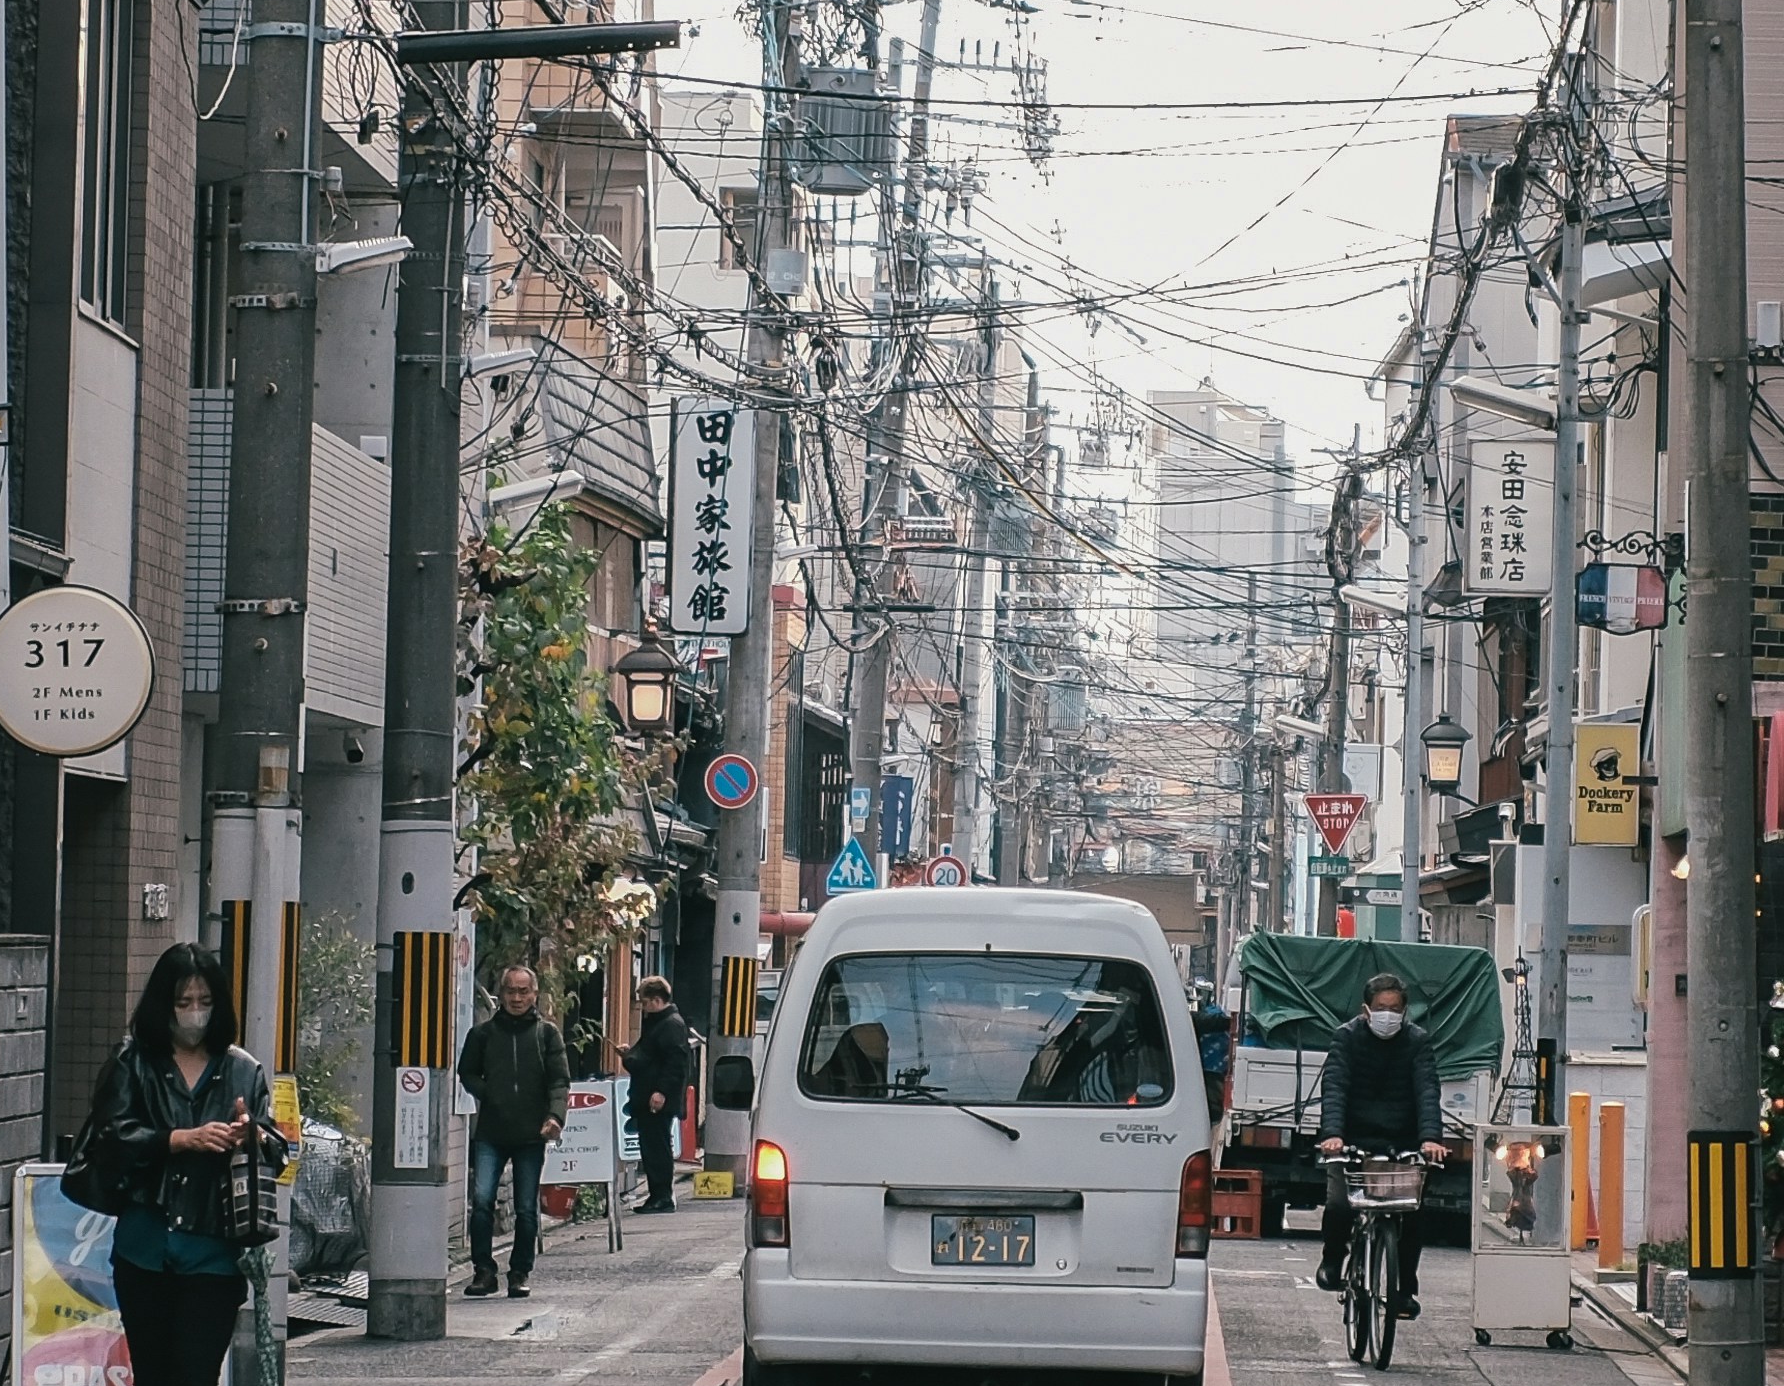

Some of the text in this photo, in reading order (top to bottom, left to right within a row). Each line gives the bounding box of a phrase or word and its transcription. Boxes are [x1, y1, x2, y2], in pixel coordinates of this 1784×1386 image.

[687, 413, 733, 622] 田中家旅館
[1500, 450, 1528, 582] 安田念珠店
[1480, 505, 1494, 580] 本店営業部
[30, 622, 100, 633] サンイチナナ
[24, 639, 105, 668] 317
[32, 688, 103, 699] 2F Mens
[34, 708, 95, 721] 1F Kids
[1578, 786, 1634, 802] Dockery
[1316, 801, 1354, 815] 止まれ
[1588, 800, 1623, 813] Farm
[1323, 818, 1350, 829] STOP
[935, 868, 957, 886] 20
[1117, 1124, 1158, 1132] SUZUKI
[1100, 1132, 1177, 1144] EVERY
[562, 1160, 578, 1172] 2F
[959, 1236, 1030, 1261] 12-17
